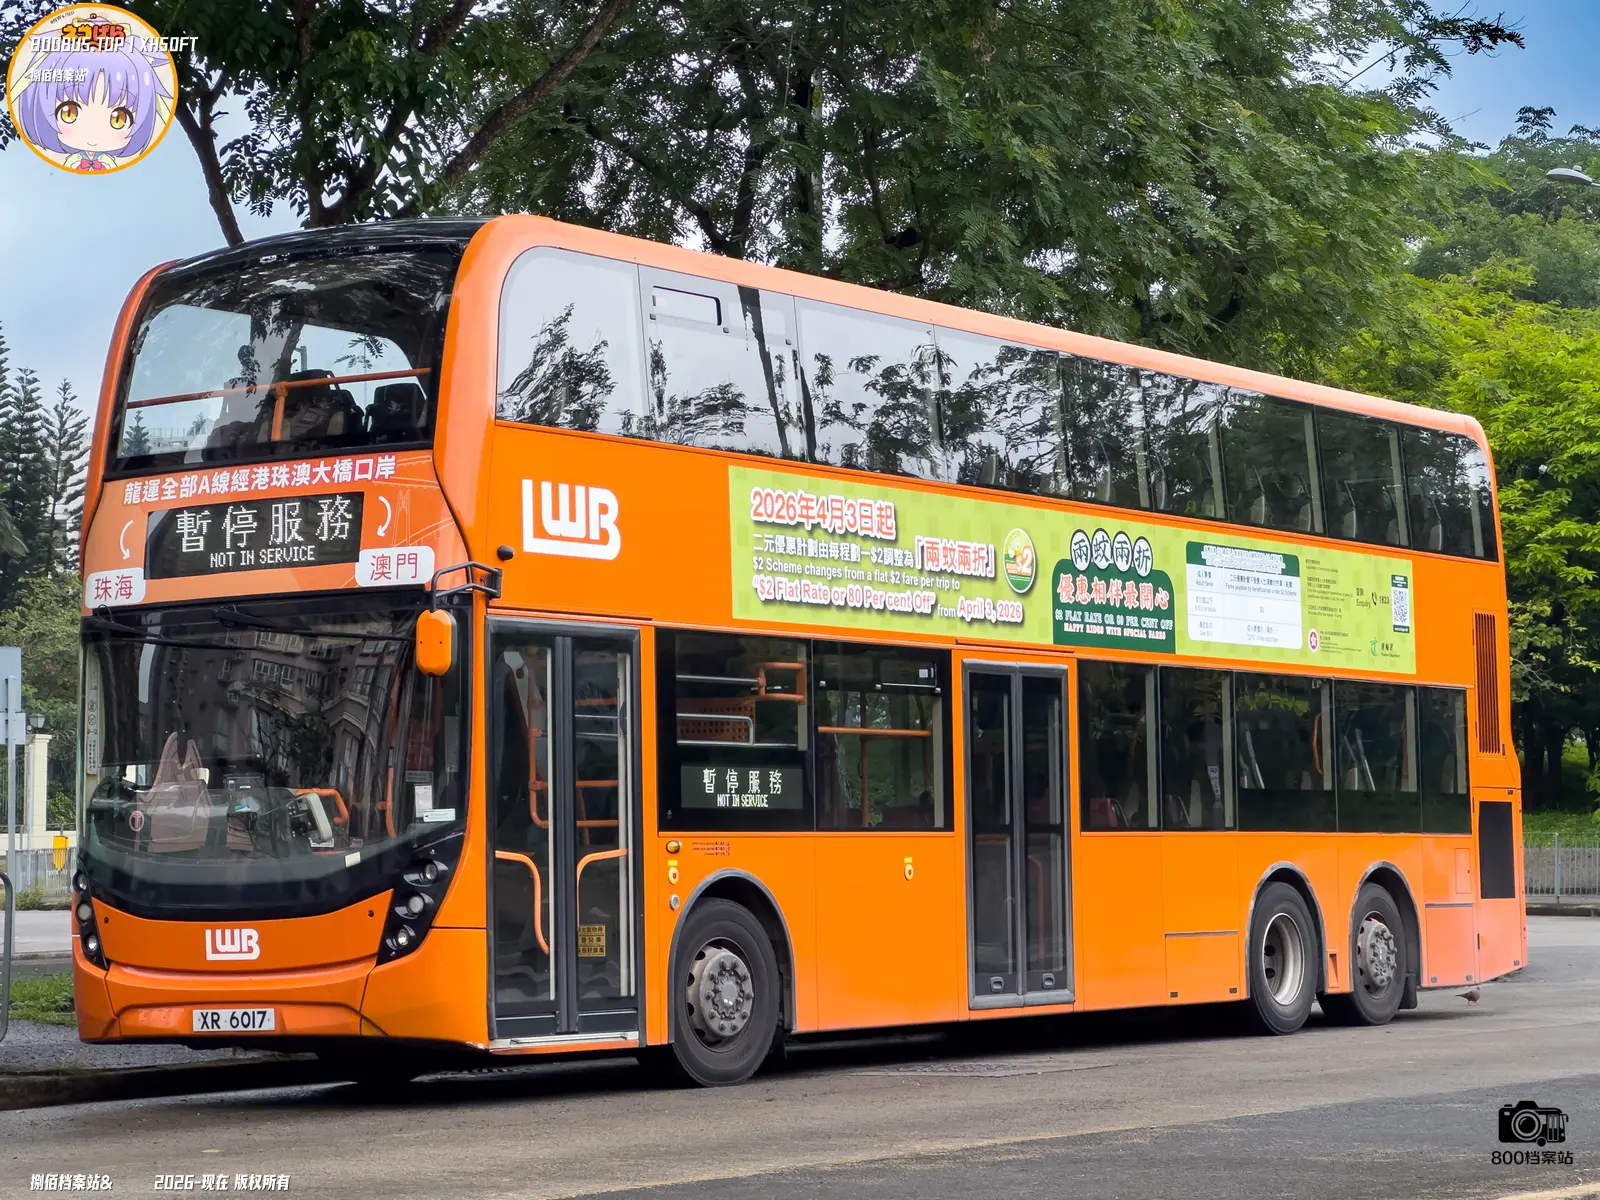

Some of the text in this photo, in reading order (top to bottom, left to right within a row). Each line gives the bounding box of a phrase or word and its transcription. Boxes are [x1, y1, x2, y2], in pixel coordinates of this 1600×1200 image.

[123, 455, 396, 505] 龍運全部A線經港珠澳大橋口岸
[175, 495, 353, 552] 暫停服務
[521, 478, 621, 561] LWB
[751, 487, 896, 540] 2026年4月3日起
[210, 545, 316, 568] NOT IN SERVICE
[369, 552, 418, 582] 澳門
[1071, 533, 1152, 574] 兩蚊兩折
[94, 575, 134, 602] 珠海
[753, 556, 960, 591] $2 Scheme changes from a flat $2 fare per trip to
[775, 576, 801, 602] Flat
[800, 578, 831, 604] Rate
[831, 586, 846, 606] or
[846, 583, 863, 607] 80
[863, 585, 886, 610] Per
[885, 589, 912, 612] cent
[937, 604, 957, 618] from
[957, 595, 985, 621] April
[984, 598, 997, 623] 3,
[997, 600, 1023, 622] 2026
[1056, 572, 1170, 612] 優惠相伴最開心
[1356, 598, 1371, 609] Enquiry
[1379, 595, 1390, 605] 1823
[702, 768, 783, 795] 暫停服務
[717, 794, 769, 808] NOT IN SERVICE
[205, 928, 260, 961] LWB
[200, 1010, 268, 1030] XR 6017
